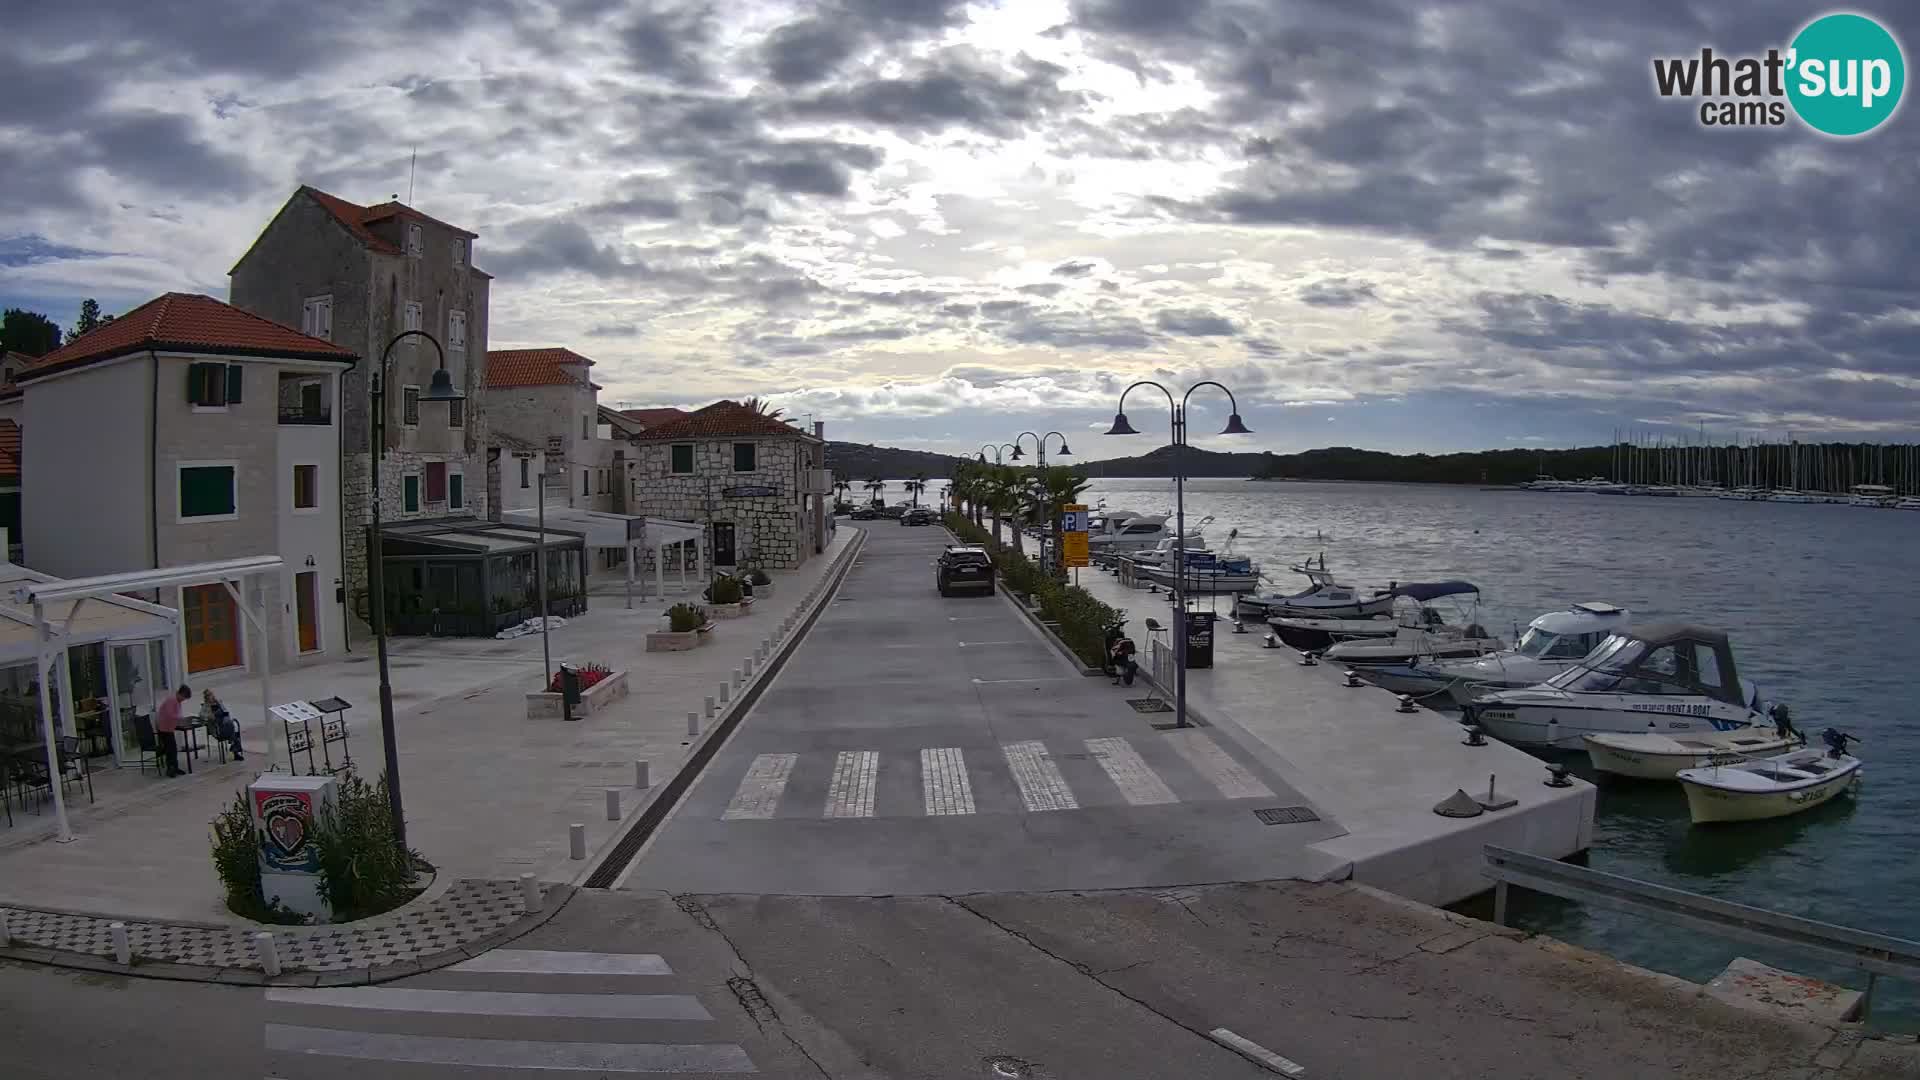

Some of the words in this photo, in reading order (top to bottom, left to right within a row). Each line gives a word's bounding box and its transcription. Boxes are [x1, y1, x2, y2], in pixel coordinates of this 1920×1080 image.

[1065, 514, 1076, 530] P
[1666, 704, 1685, 714] RENT
[1686, 705, 1692, 714] A
[1693, 705, 1711, 716] BOAT
